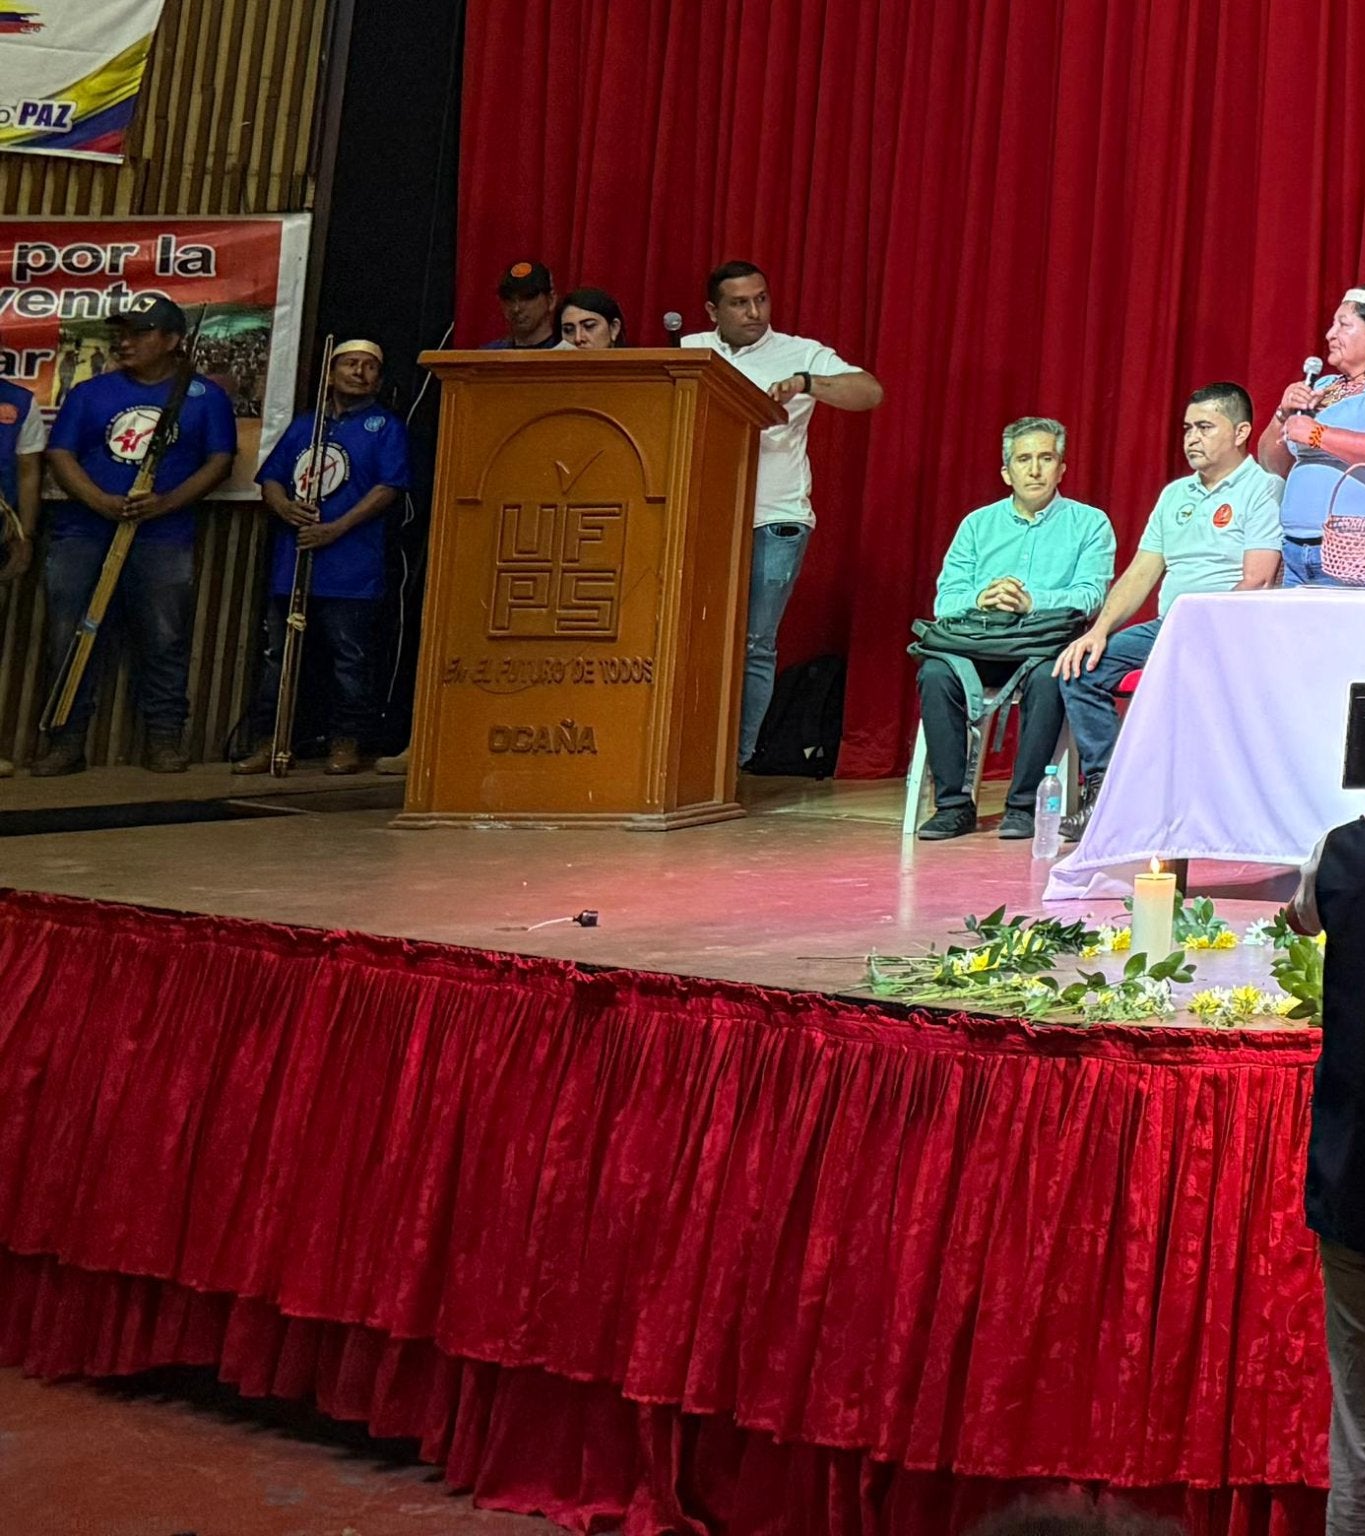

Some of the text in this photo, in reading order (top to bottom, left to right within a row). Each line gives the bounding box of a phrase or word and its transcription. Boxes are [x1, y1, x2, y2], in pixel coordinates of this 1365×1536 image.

[18, 101, 72, 129] PAZ
[14, 234, 216, 283] por la
[487, 718, 598, 755] OCAÑA
